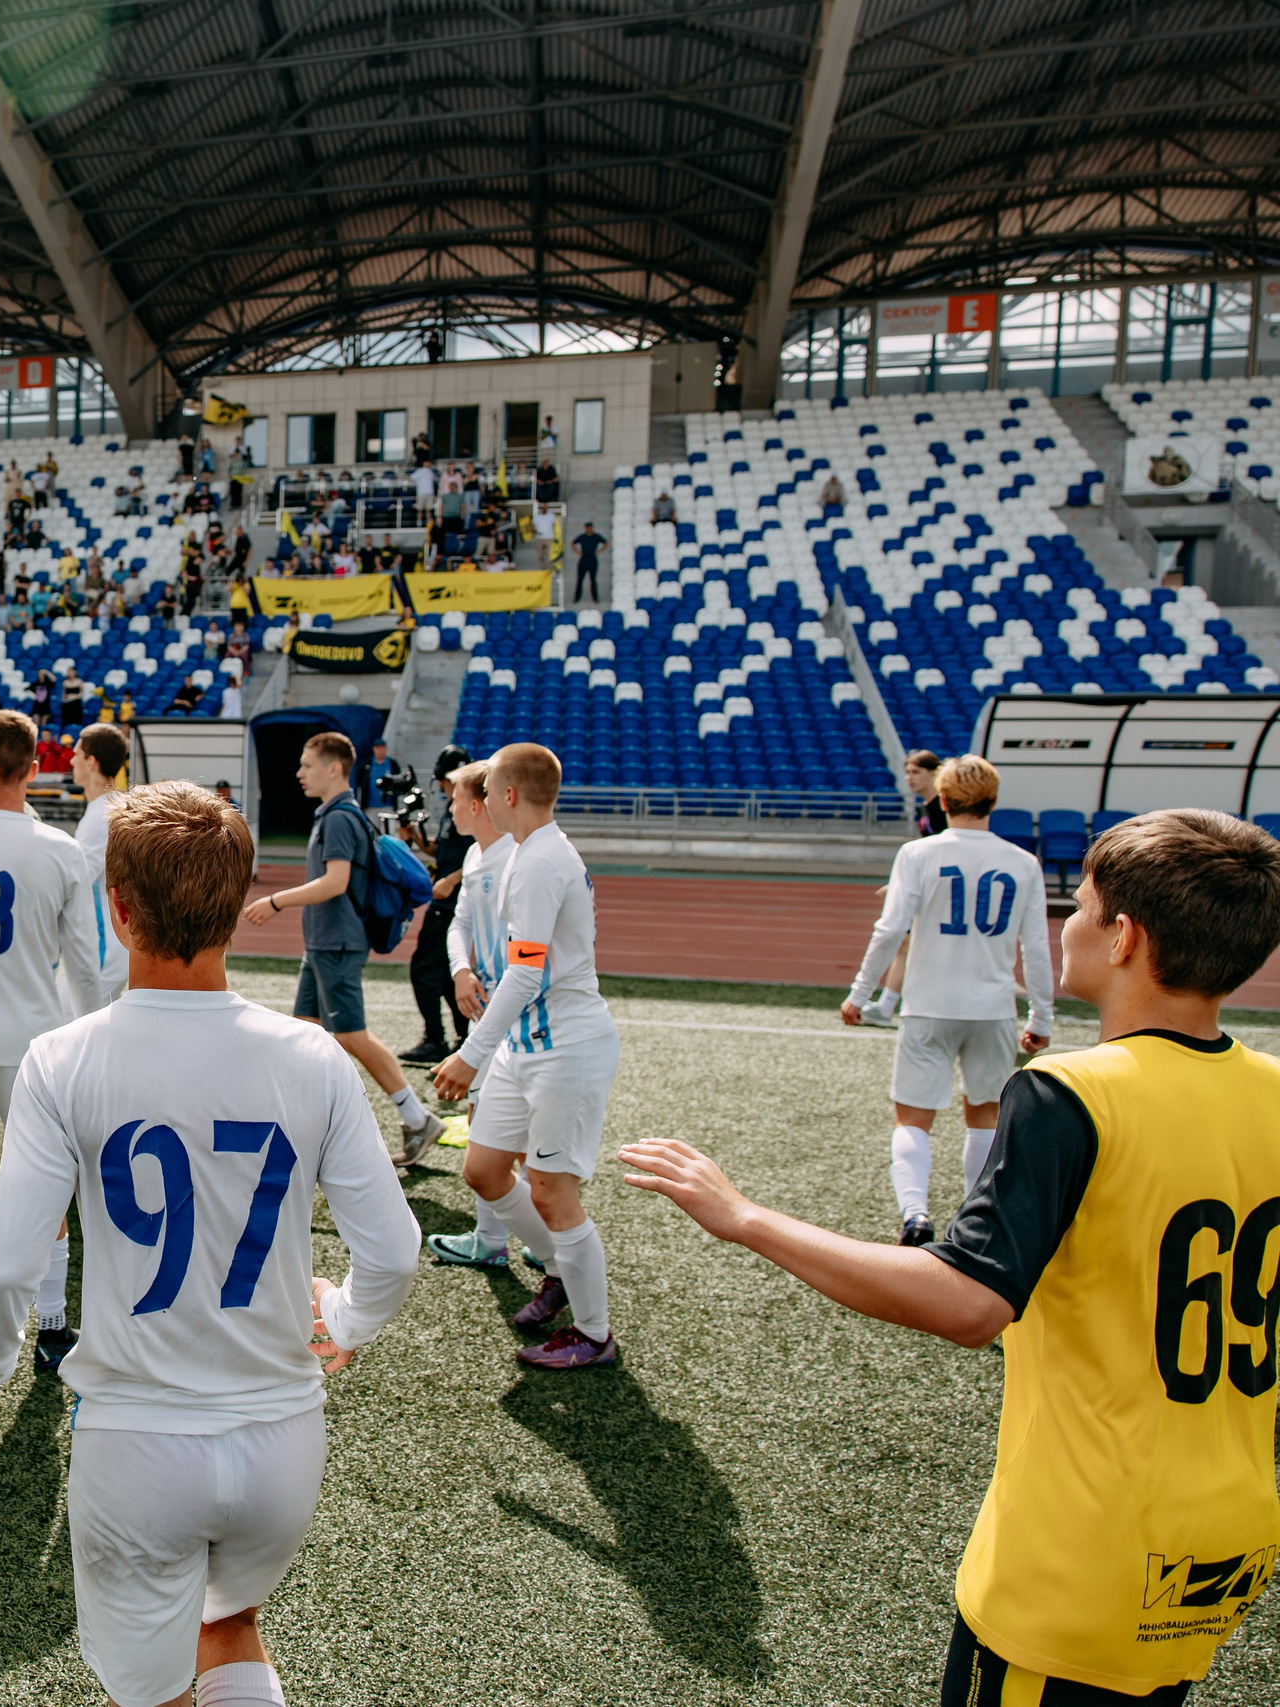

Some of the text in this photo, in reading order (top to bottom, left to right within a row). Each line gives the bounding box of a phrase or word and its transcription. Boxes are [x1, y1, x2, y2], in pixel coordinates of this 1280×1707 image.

[963, 299, 979, 328] E
[940, 865, 1017, 937] 10
[100, 1119, 298, 1317] 97
[1154, 1195, 1280, 1404] 69
[1136, 1632, 1171, 1642] ЛЕГКИХ
[1138, 1613, 1222, 1631] ИННОВАЦИОННЫЙ
